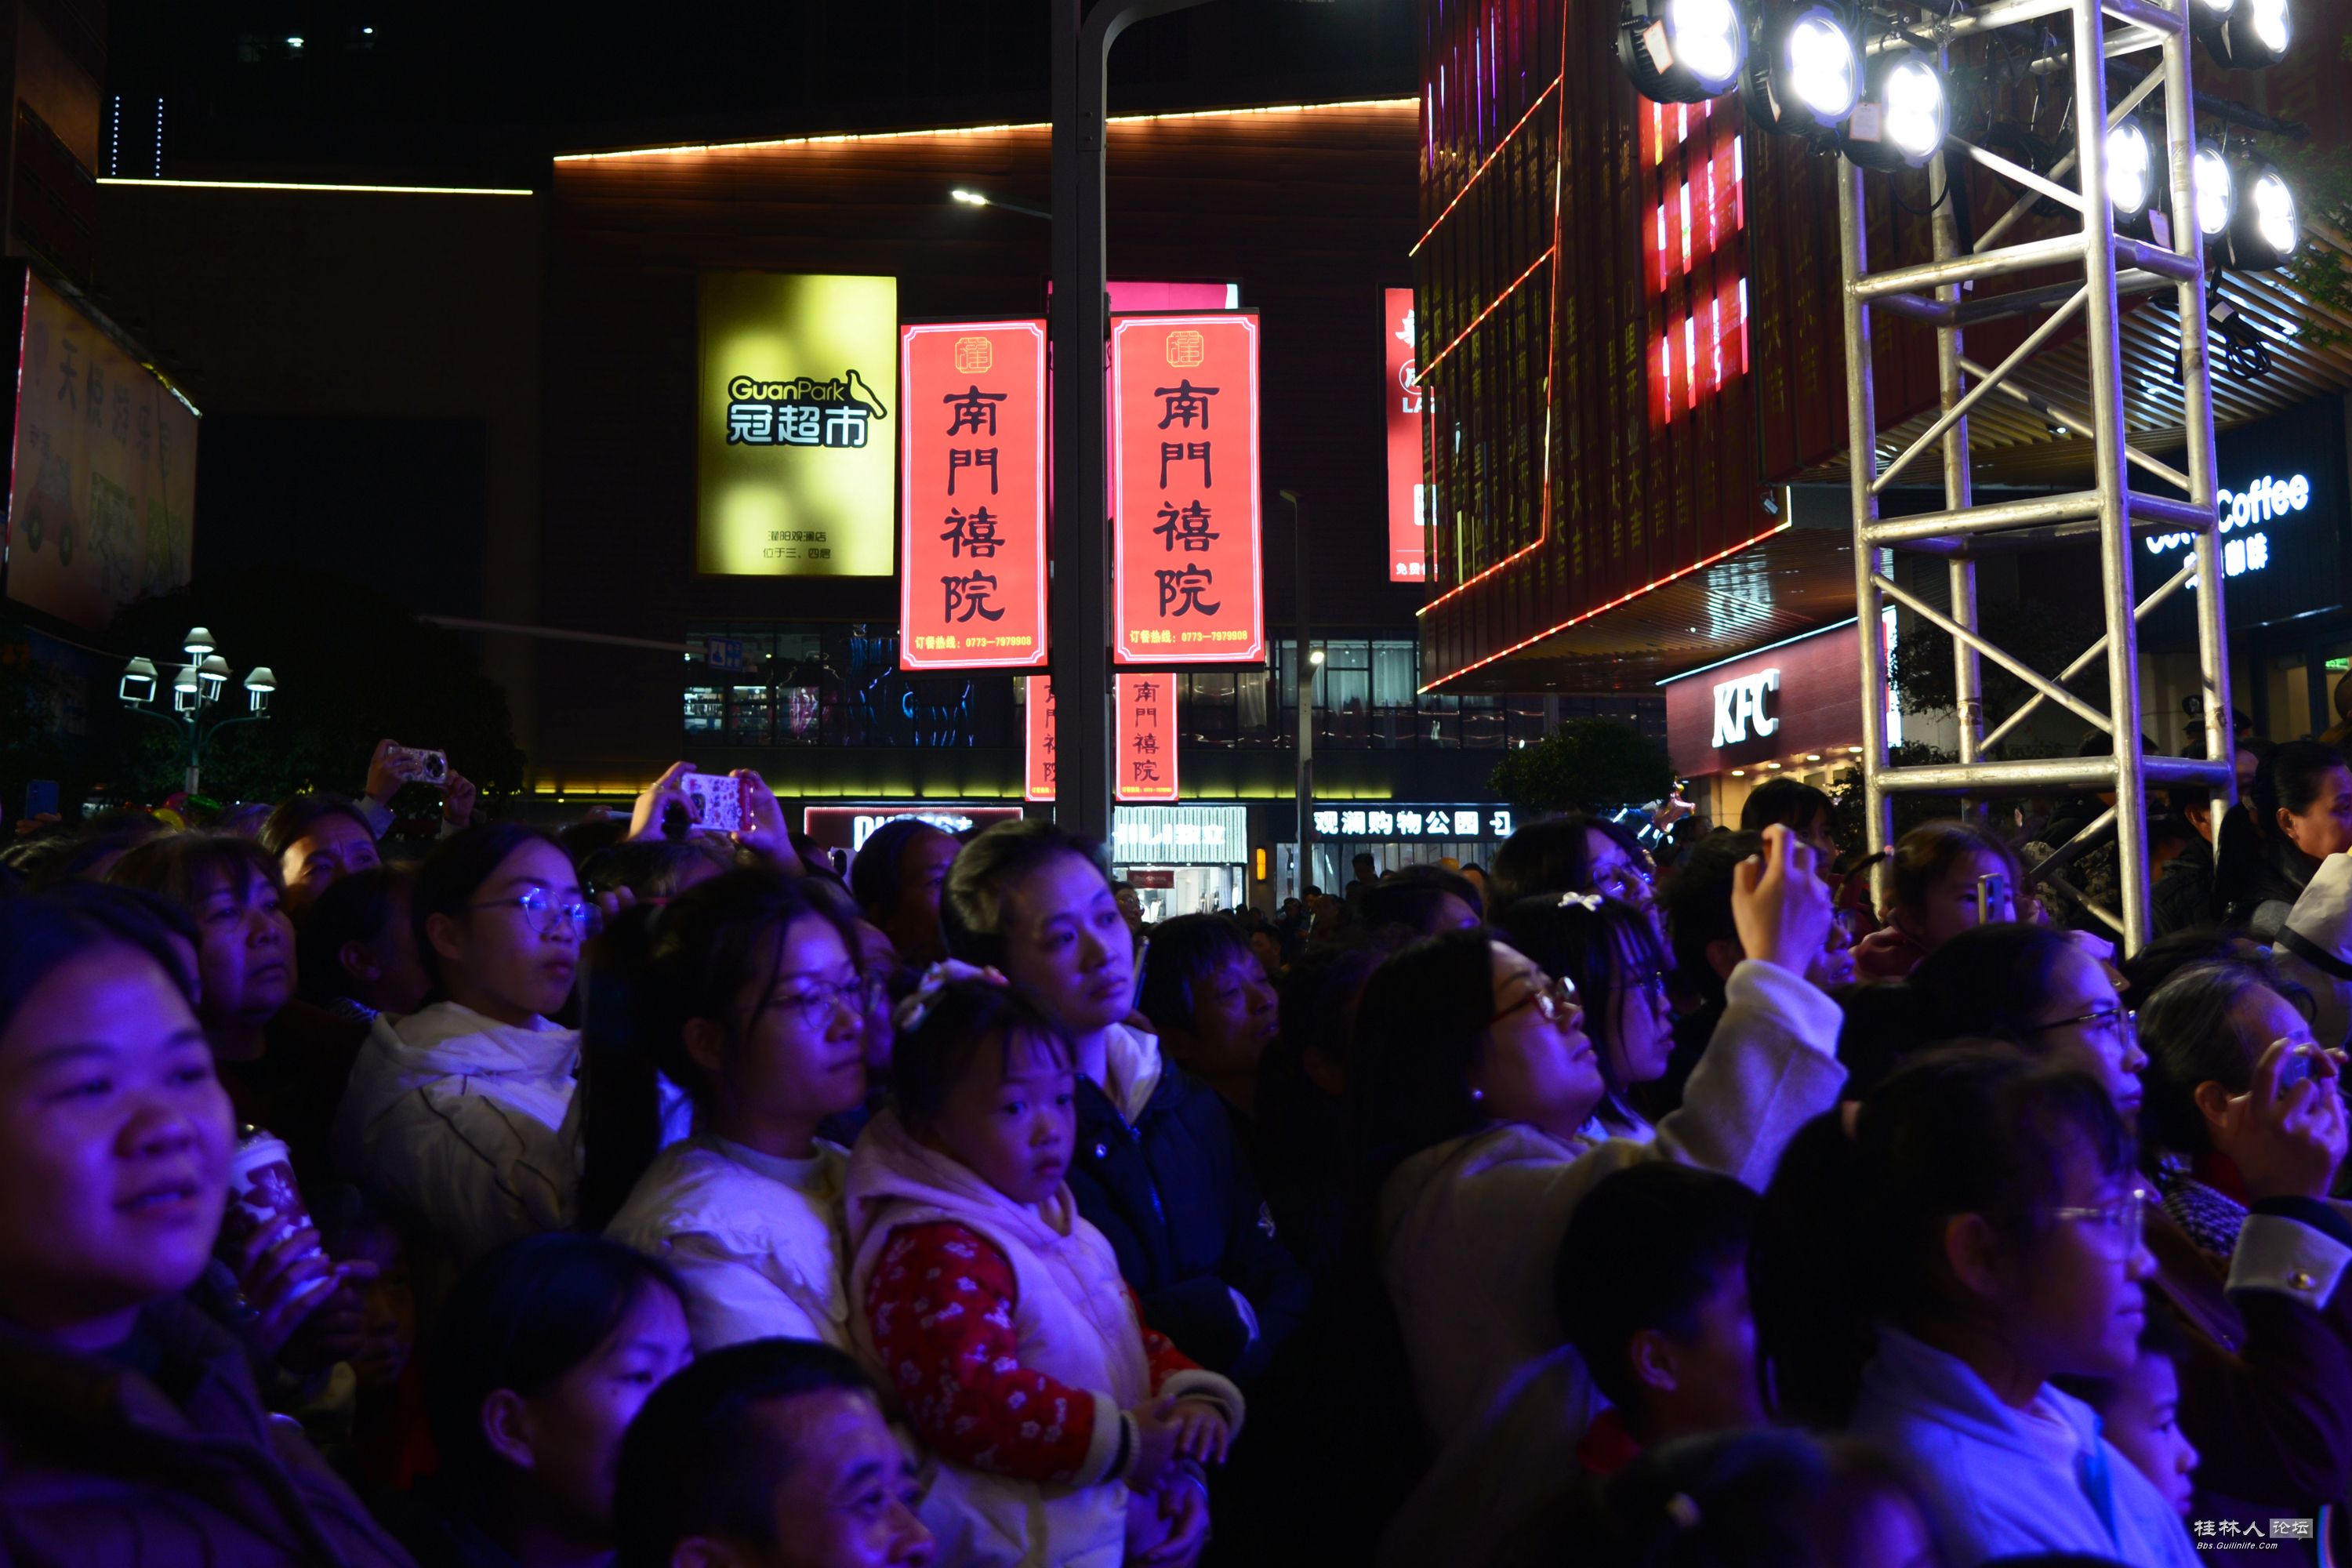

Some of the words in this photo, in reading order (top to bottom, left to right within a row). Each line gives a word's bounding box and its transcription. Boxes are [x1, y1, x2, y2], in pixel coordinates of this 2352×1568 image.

[731, 378, 845, 401] GuanPark
[730, 404, 867, 445] 冠超市
[940, 385, 1008, 623] 南門禧院
[1153, 379, 1221, 617] 南門禧院
[2216, 474, 2310, 534] Coffee
[1711, 668, 1780, 748] KFC
[1313, 811, 1479, 835] 观澜购物公园
